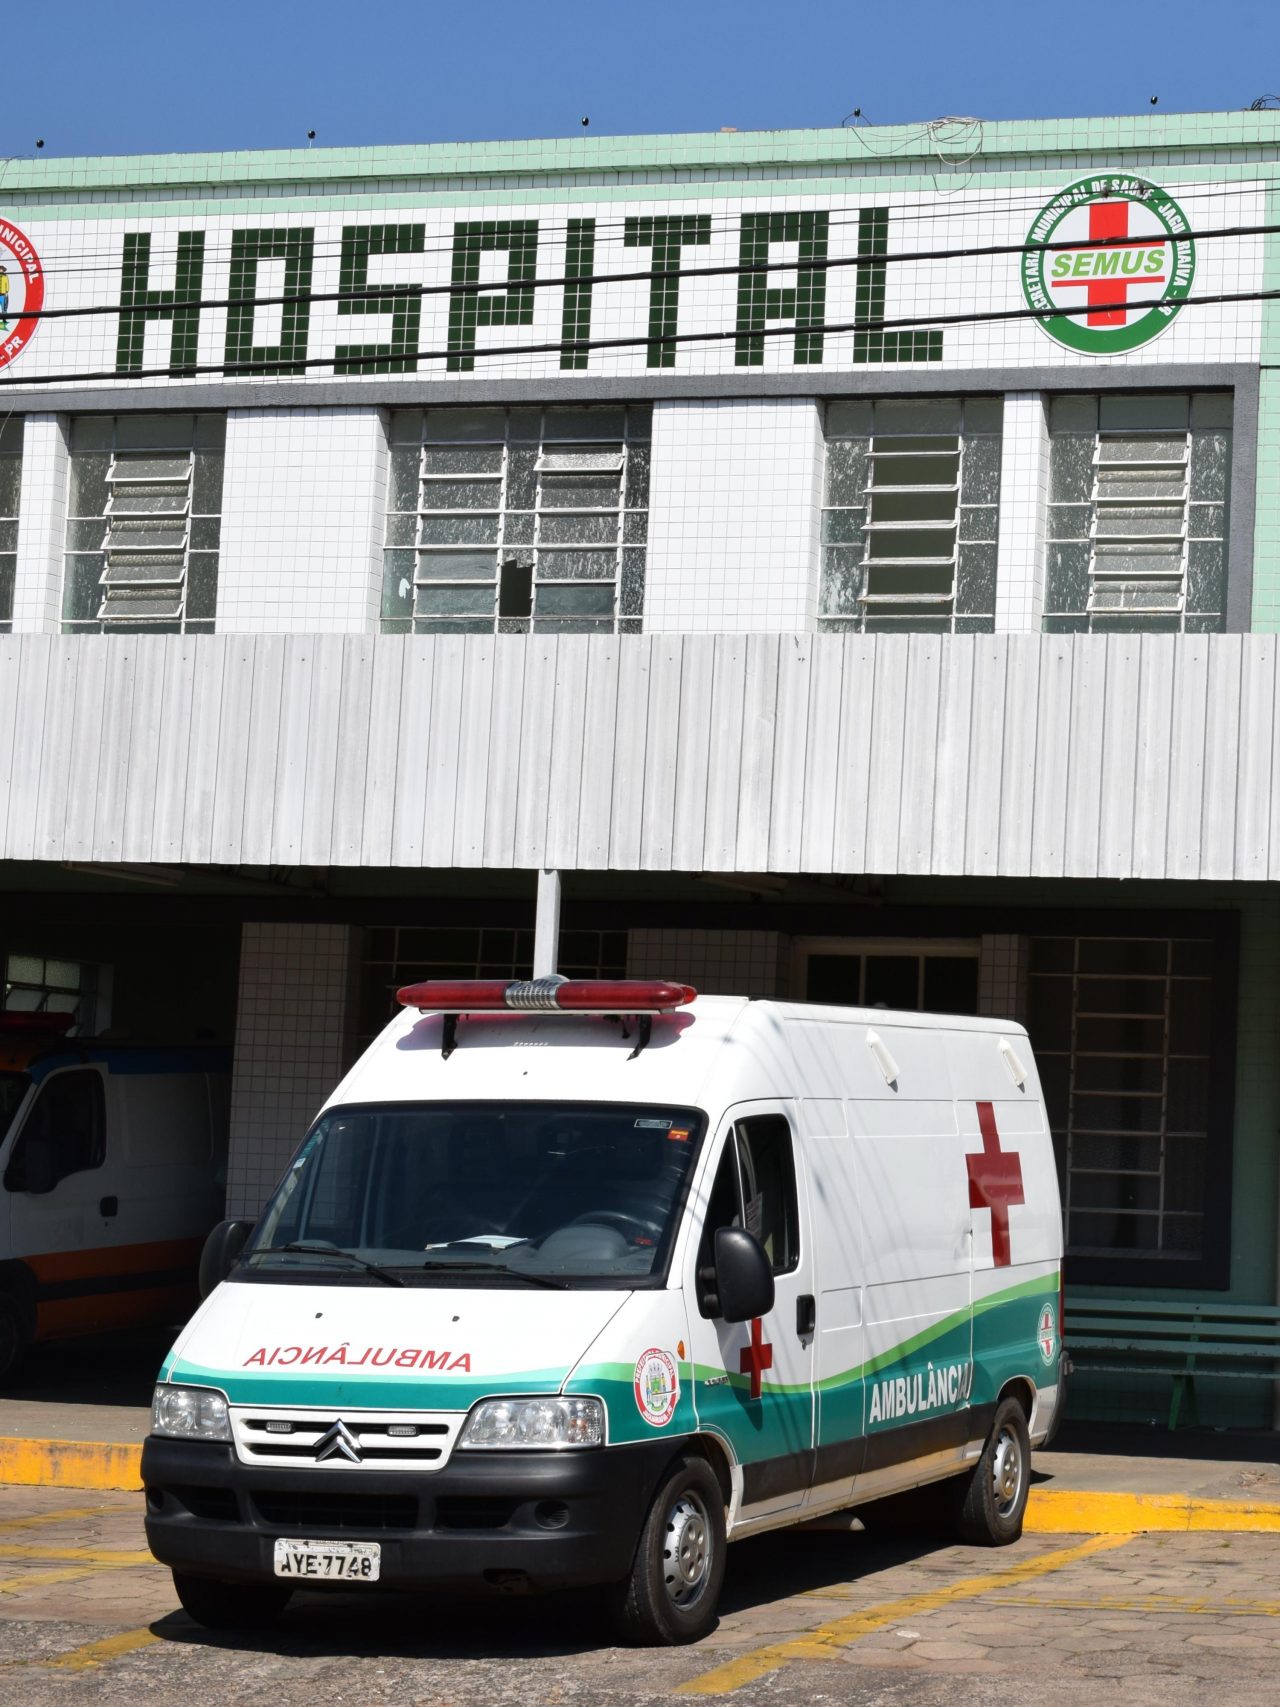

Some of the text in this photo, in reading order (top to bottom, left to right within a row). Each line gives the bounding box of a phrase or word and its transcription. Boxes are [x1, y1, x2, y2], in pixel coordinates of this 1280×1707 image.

[1031, 187, 1091, 242] MUNICIPAL
[1051, 249, 1165, 278] SEMUS
[117, 206, 943, 378] HOSPITAL
[5, 335, 24, 356] PR
